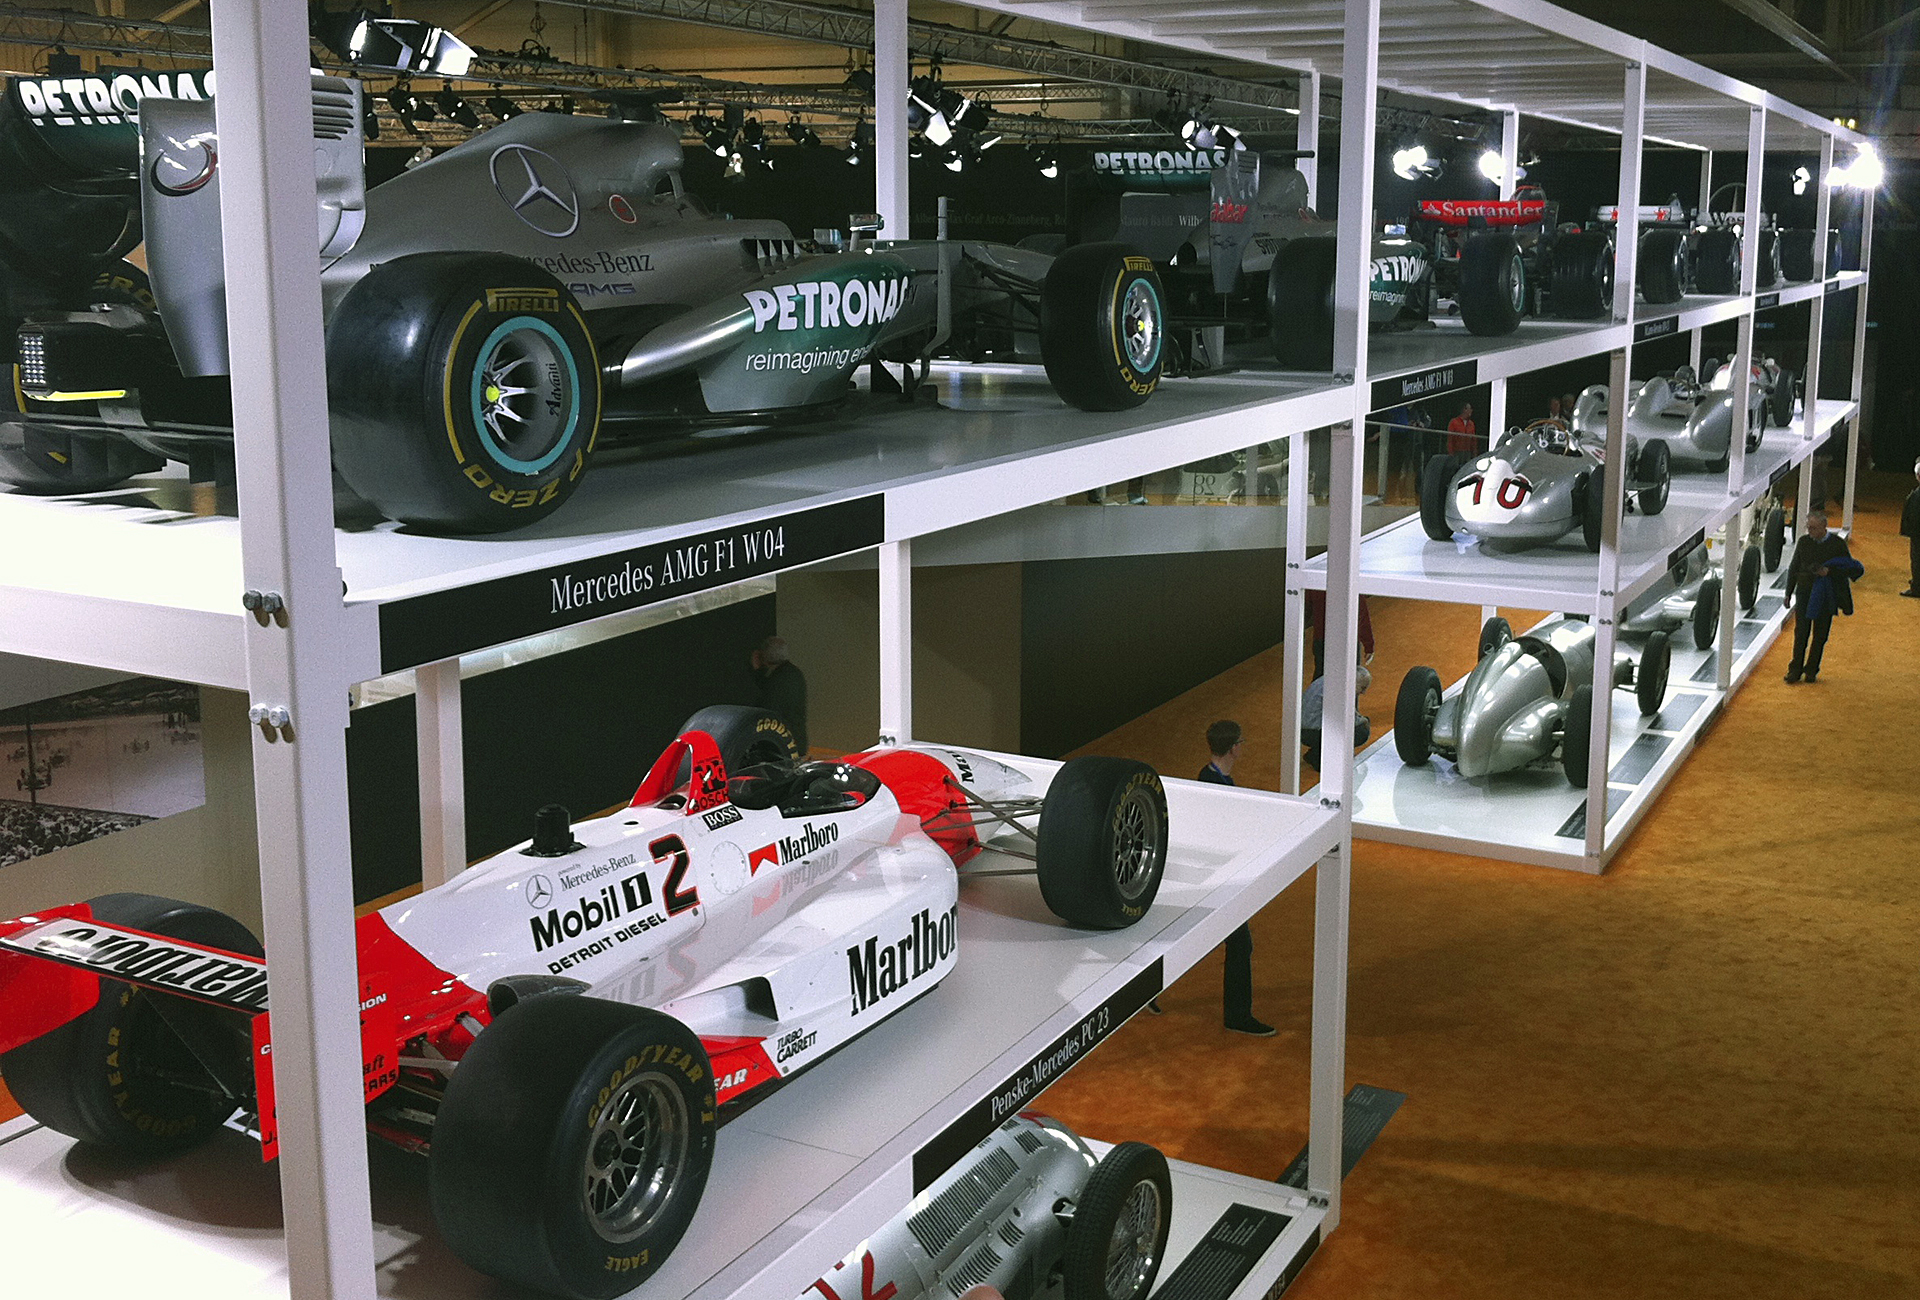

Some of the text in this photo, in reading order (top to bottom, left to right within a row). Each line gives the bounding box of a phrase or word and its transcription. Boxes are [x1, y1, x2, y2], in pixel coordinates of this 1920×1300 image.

[18, 70, 214, 126] PETRONA
[1093, 150, 1226, 175] PETRONAS
[1442, 201, 1542, 217] Santander
[1710, 212, 1744, 225] Wes
[485, 287, 559, 312] PIRELLI
[745, 345, 850, 374] reimagining
[462, 463, 560, 508] ZERO
[1458, 474, 1532, 510] 10
[550, 562, 654, 615] Mercedes
[659, 543, 709, 587] AMG
[714, 537, 735, 572] F1
[704, 806, 739, 827] BOSS
[778, 822, 839, 866] Marlboro
[559, 854, 637, 892] Mercedes-Benz
[648, 834, 701, 918] 2
[529, 884, 621, 953] Mobil
[547, 912, 668, 975] DETROIT DIESEL
[846, 901, 958, 1017] Marlbor
[776, 1028, 803, 1050] TURBO
[776, 1030, 818, 1063] GARRETT
[990, 1006, 1109, 1122] Penske-Mercedes PC 23
[588, 1045, 704, 1129] GOODYEAR
[605, 1249, 650, 1273] EAGLE
